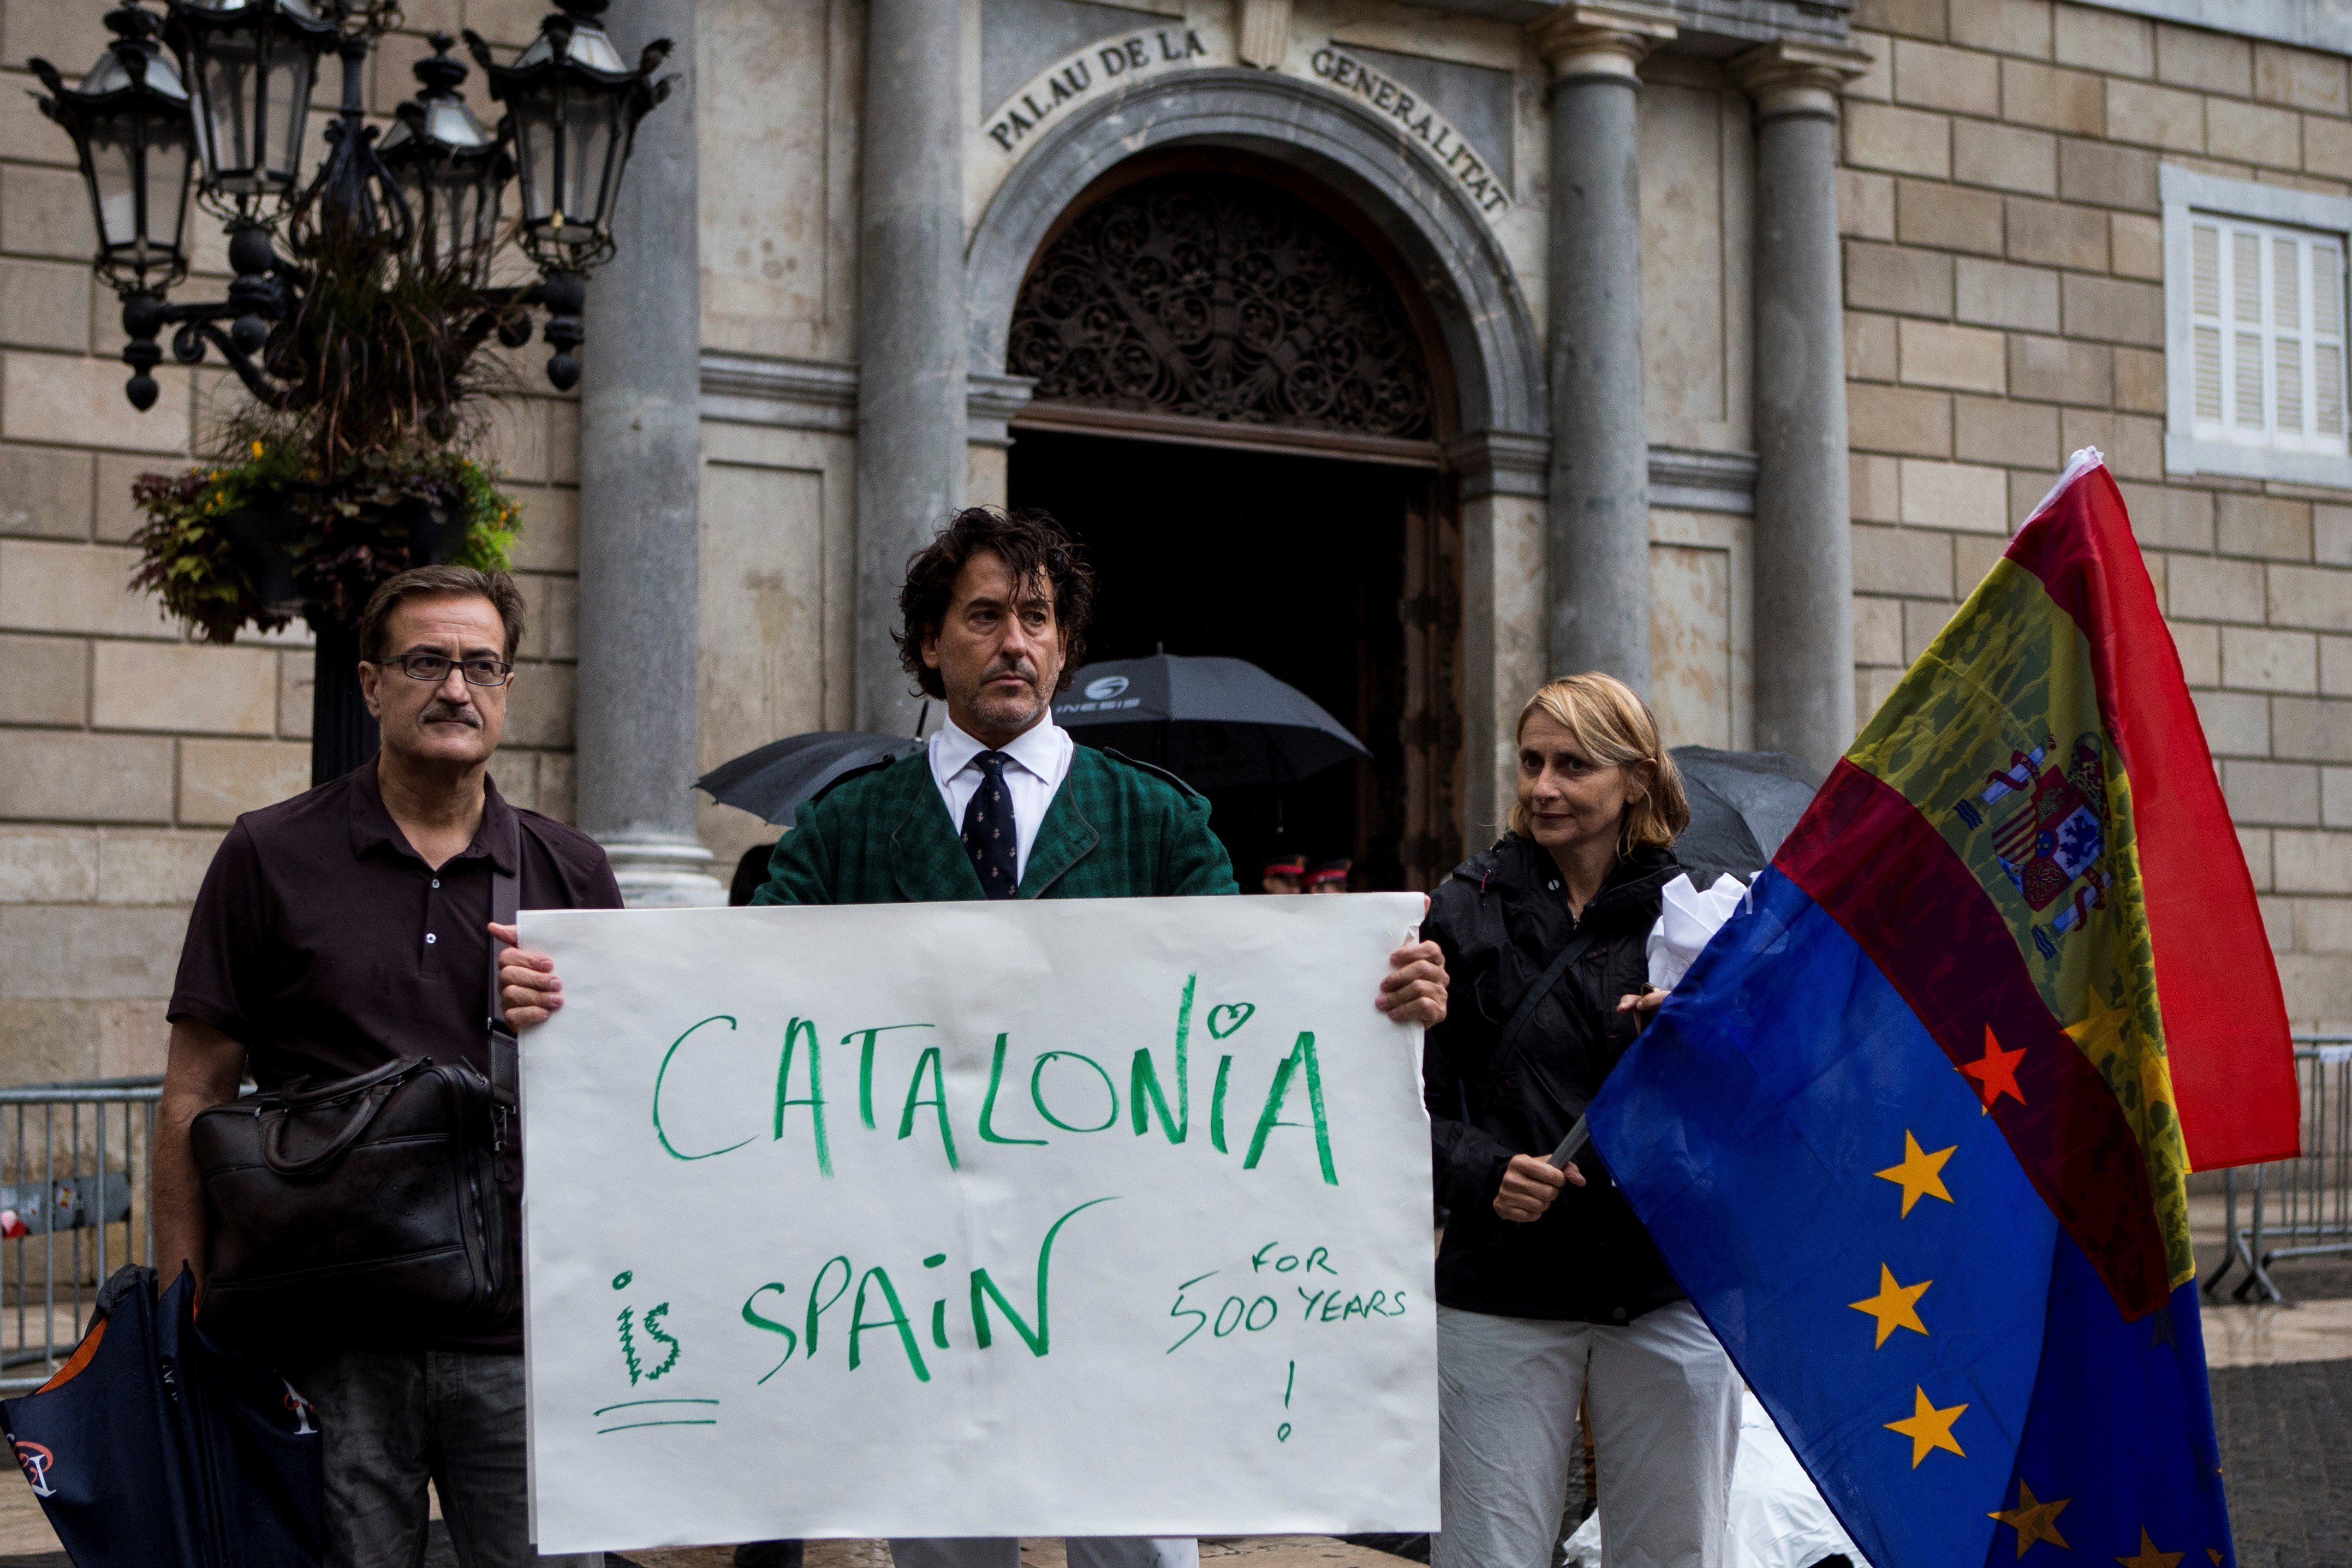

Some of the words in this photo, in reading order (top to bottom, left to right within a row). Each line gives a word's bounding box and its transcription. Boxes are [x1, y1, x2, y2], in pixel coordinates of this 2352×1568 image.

[989, 58, 1092, 153] PALAU
[1098, 38, 1150, 77] DE
[1156, 29, 1207, 61] LA
[1311, 47, 1509, 212] GENERALITAT
[1252, 1241, 1338, 1275] FOR
[1166, 1270, 1279, 1355] 500
[1298, 1285, 1407, 1322] YEARS
[1277, 1360, 1295, 1443] !
